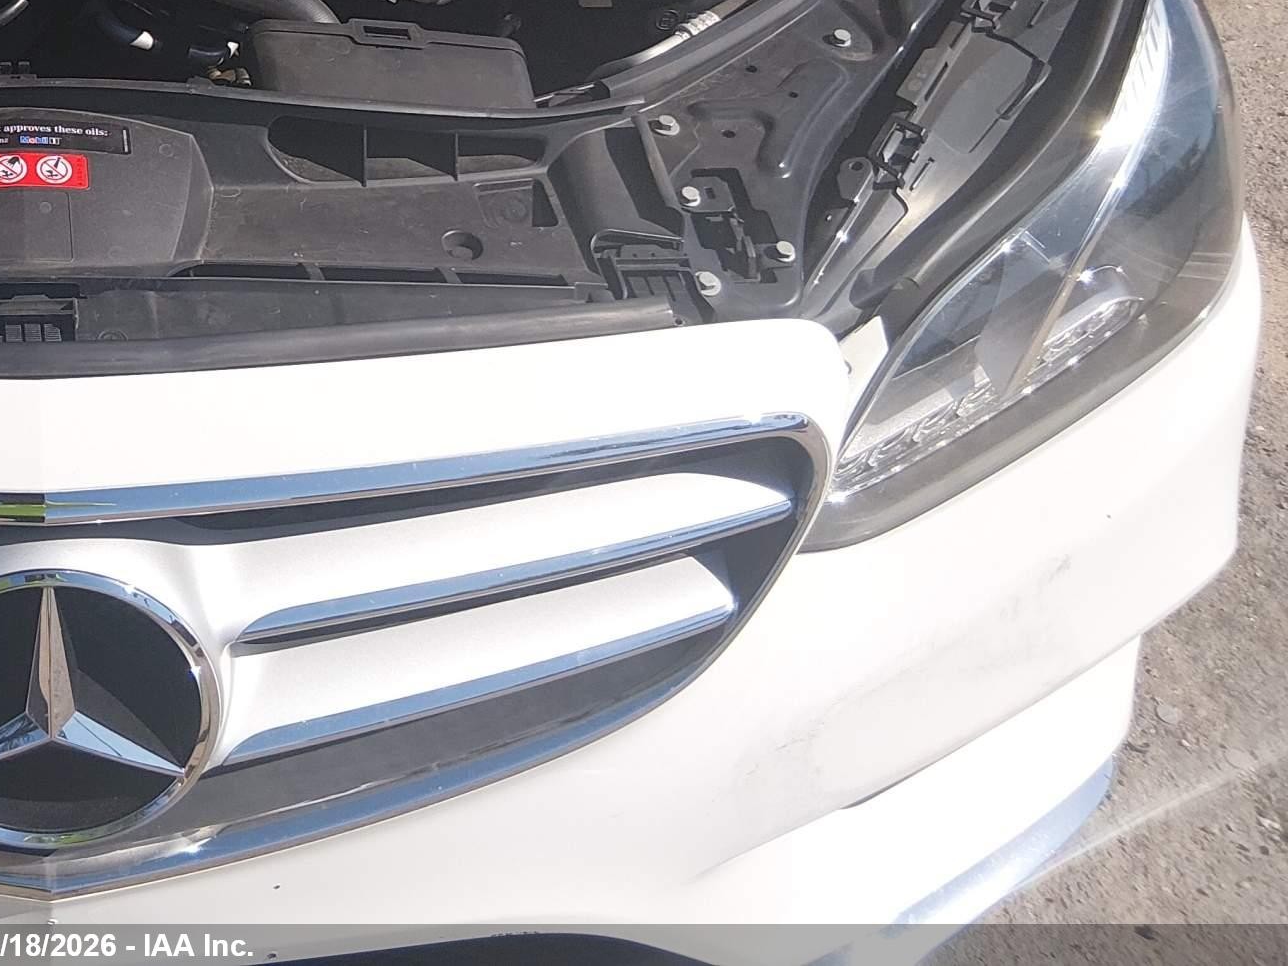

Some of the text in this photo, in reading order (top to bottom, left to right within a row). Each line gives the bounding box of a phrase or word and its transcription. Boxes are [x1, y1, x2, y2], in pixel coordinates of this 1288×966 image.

[3, 125, 51, 133] approves
[54, 125, 83, 134] these
[85, 128, 108, 136] oils:
